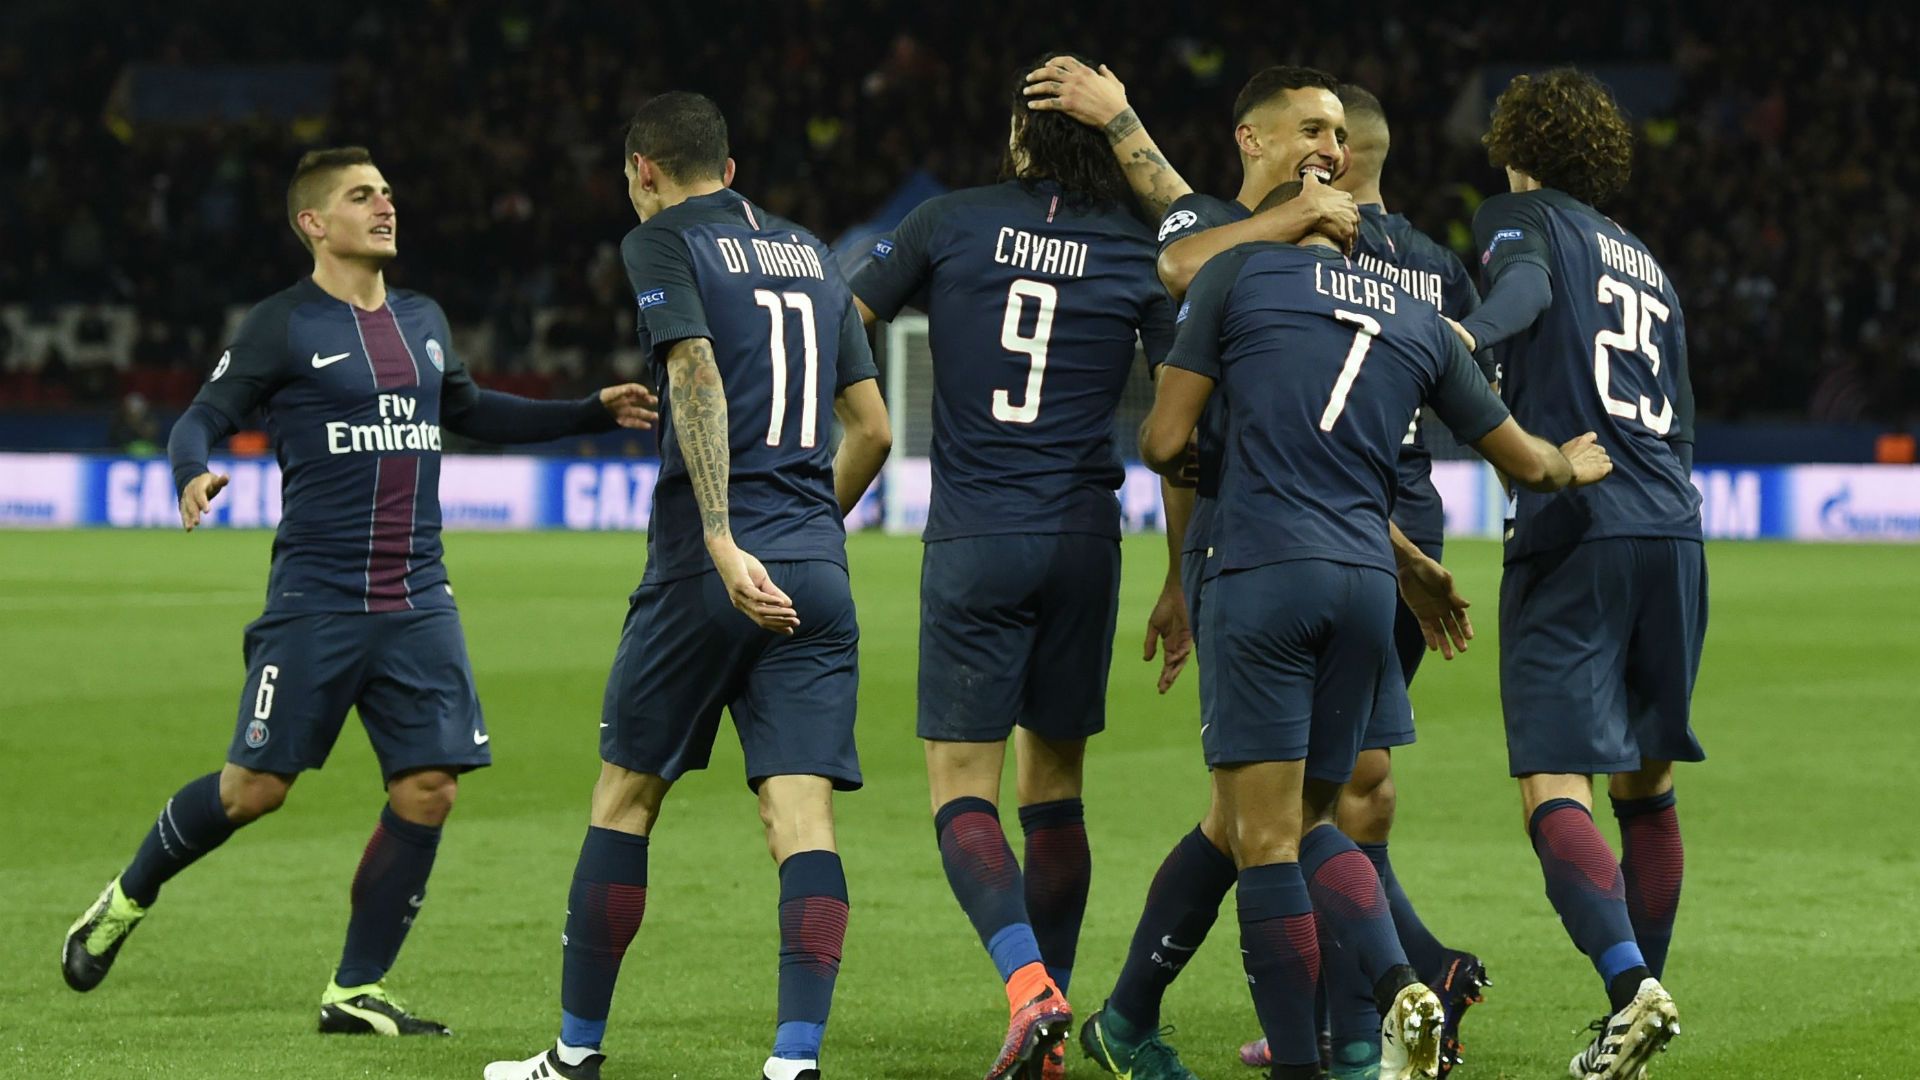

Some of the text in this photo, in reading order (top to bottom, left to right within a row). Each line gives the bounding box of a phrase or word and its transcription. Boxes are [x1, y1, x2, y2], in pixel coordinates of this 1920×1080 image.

[717, 238, 749, 274] DI
[994, 226, 1088, 278] CAVANI
[1315, 262, 1396, 315] LUCAS
[754, 288, 818, 448] 11
[992, 278, 1057, 424] 9
[1319, 308, 1382, 432] 7
[1594, 273, 1673, 435] 25
[378, 394, 416, 420] Fly
[325, 417, 441, 454] Emirates
[254, 664, 279, 720] 6
